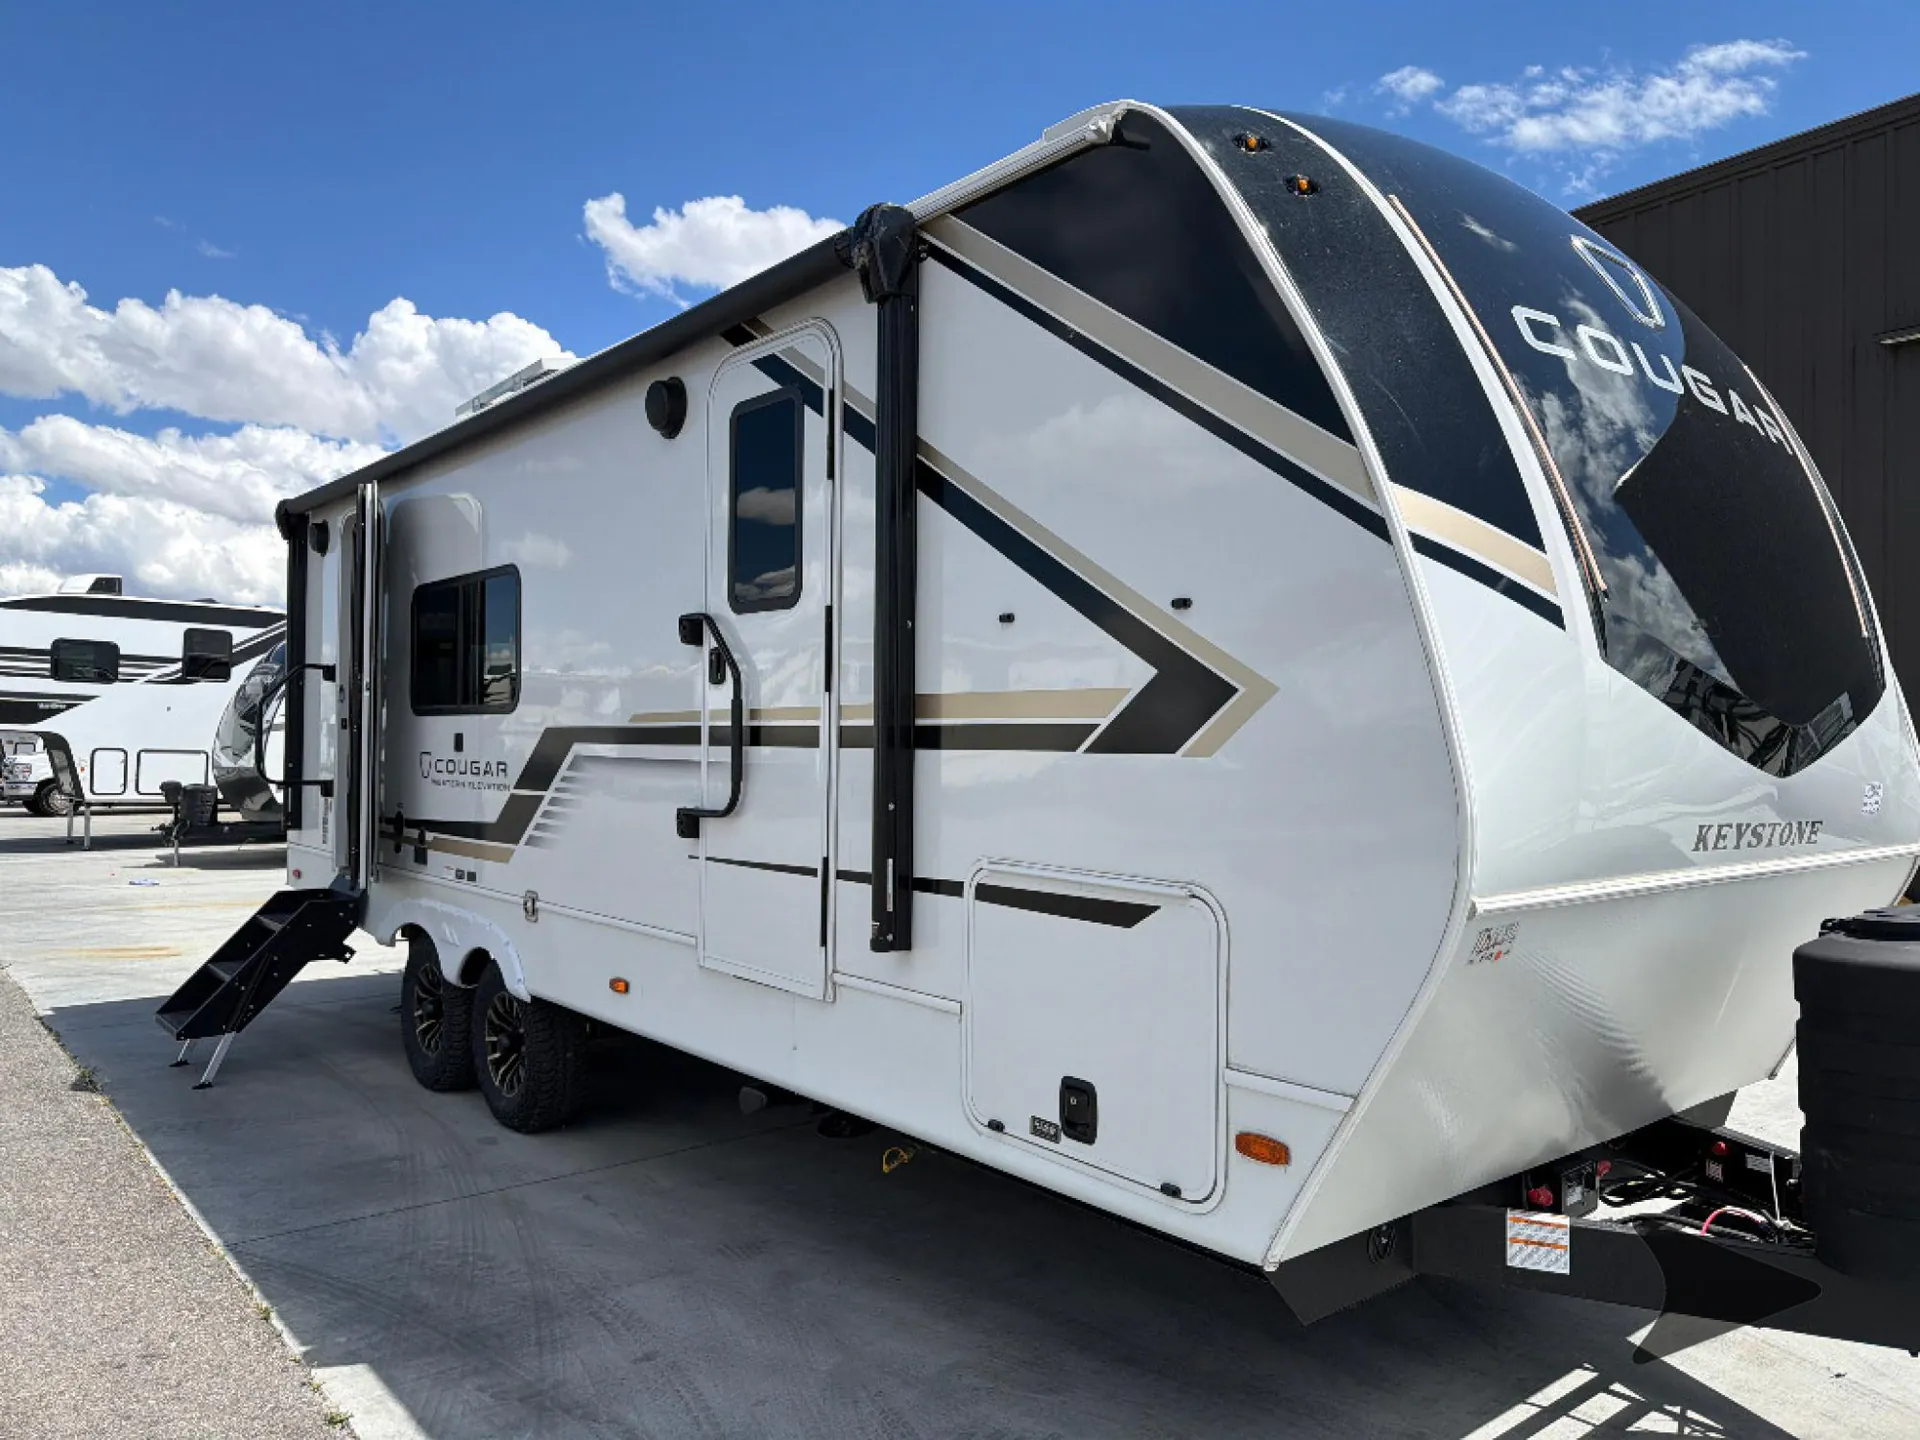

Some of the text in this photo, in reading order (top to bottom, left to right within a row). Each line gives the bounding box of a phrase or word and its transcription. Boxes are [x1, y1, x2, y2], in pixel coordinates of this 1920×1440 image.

[1511, 304, 1794, 455] COUGAR
[434, 758, 508, 778] COUGAR
[1691, 820, 1823, 852] KEYSTONE
